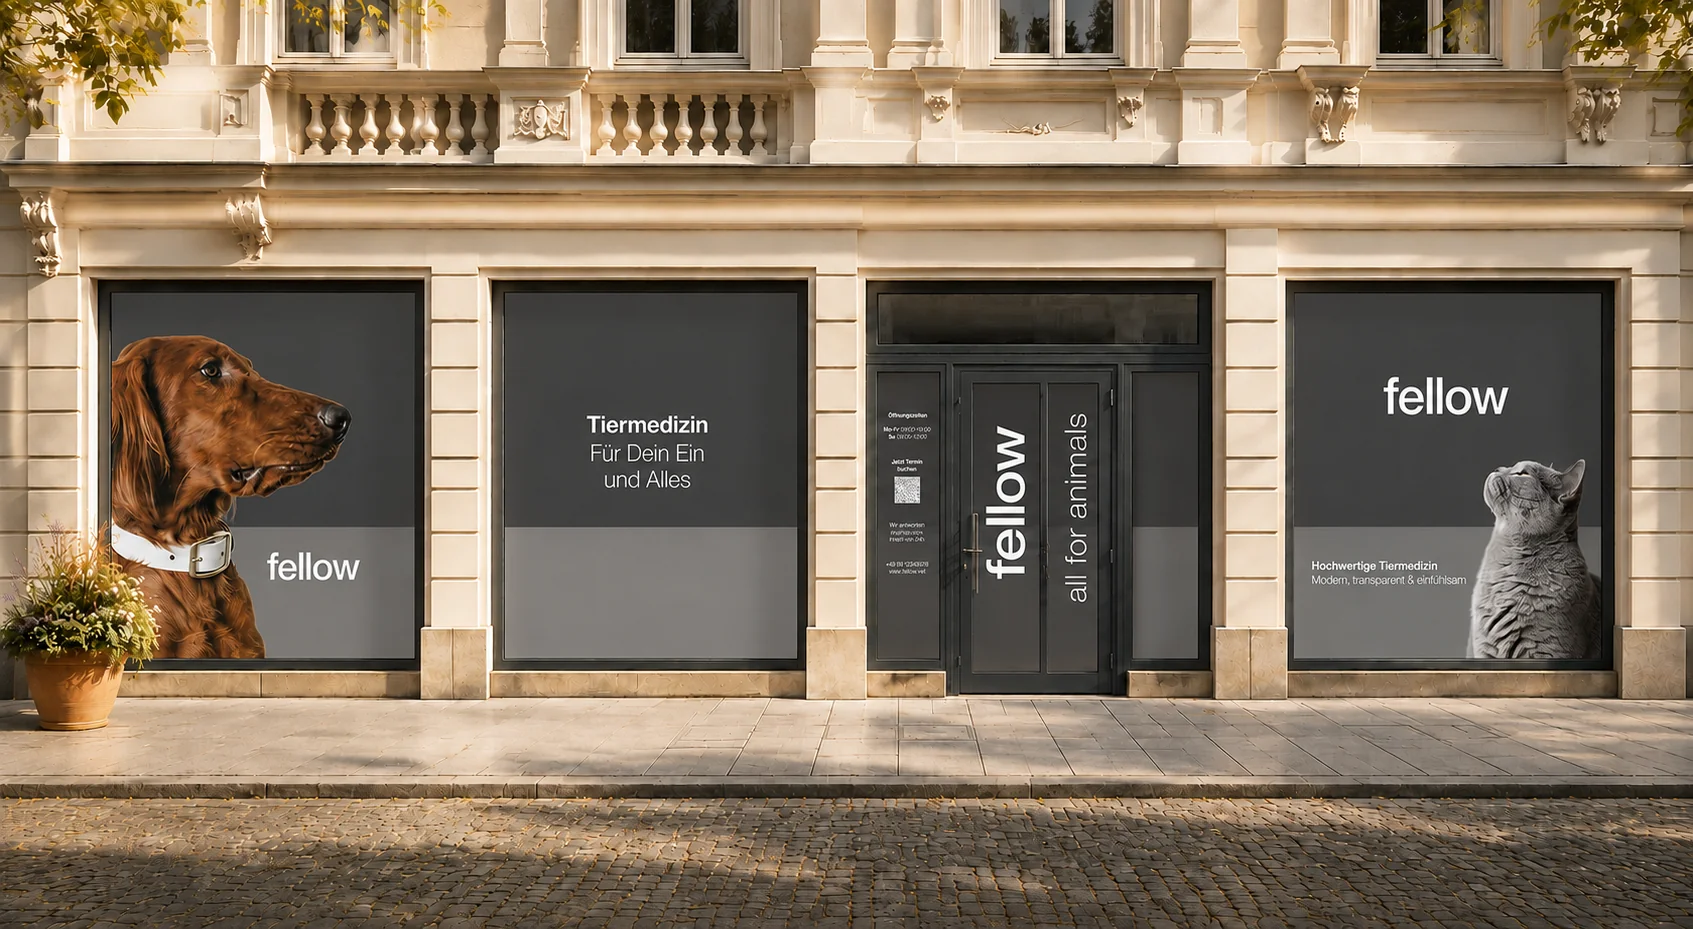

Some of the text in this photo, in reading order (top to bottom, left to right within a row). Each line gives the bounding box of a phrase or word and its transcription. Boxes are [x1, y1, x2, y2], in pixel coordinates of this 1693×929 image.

[1383, 376, 1510, 416] fellow
[586, 414, 709, 434] Tiermedizin
[590, 443, 705, 463] Für Dein Ein
[604, 469, 691, 489] und Alles
[985, 425, 1026, 580] fellow
[1063, 413, 1088, 603] all for animals
[266, 551, 361, 581] fellow
[1311, 560, 1438, 573] Hochwertige Tiermedizin
[1311, 574, 1467, 587] Modern, transparent & einfühlsam
